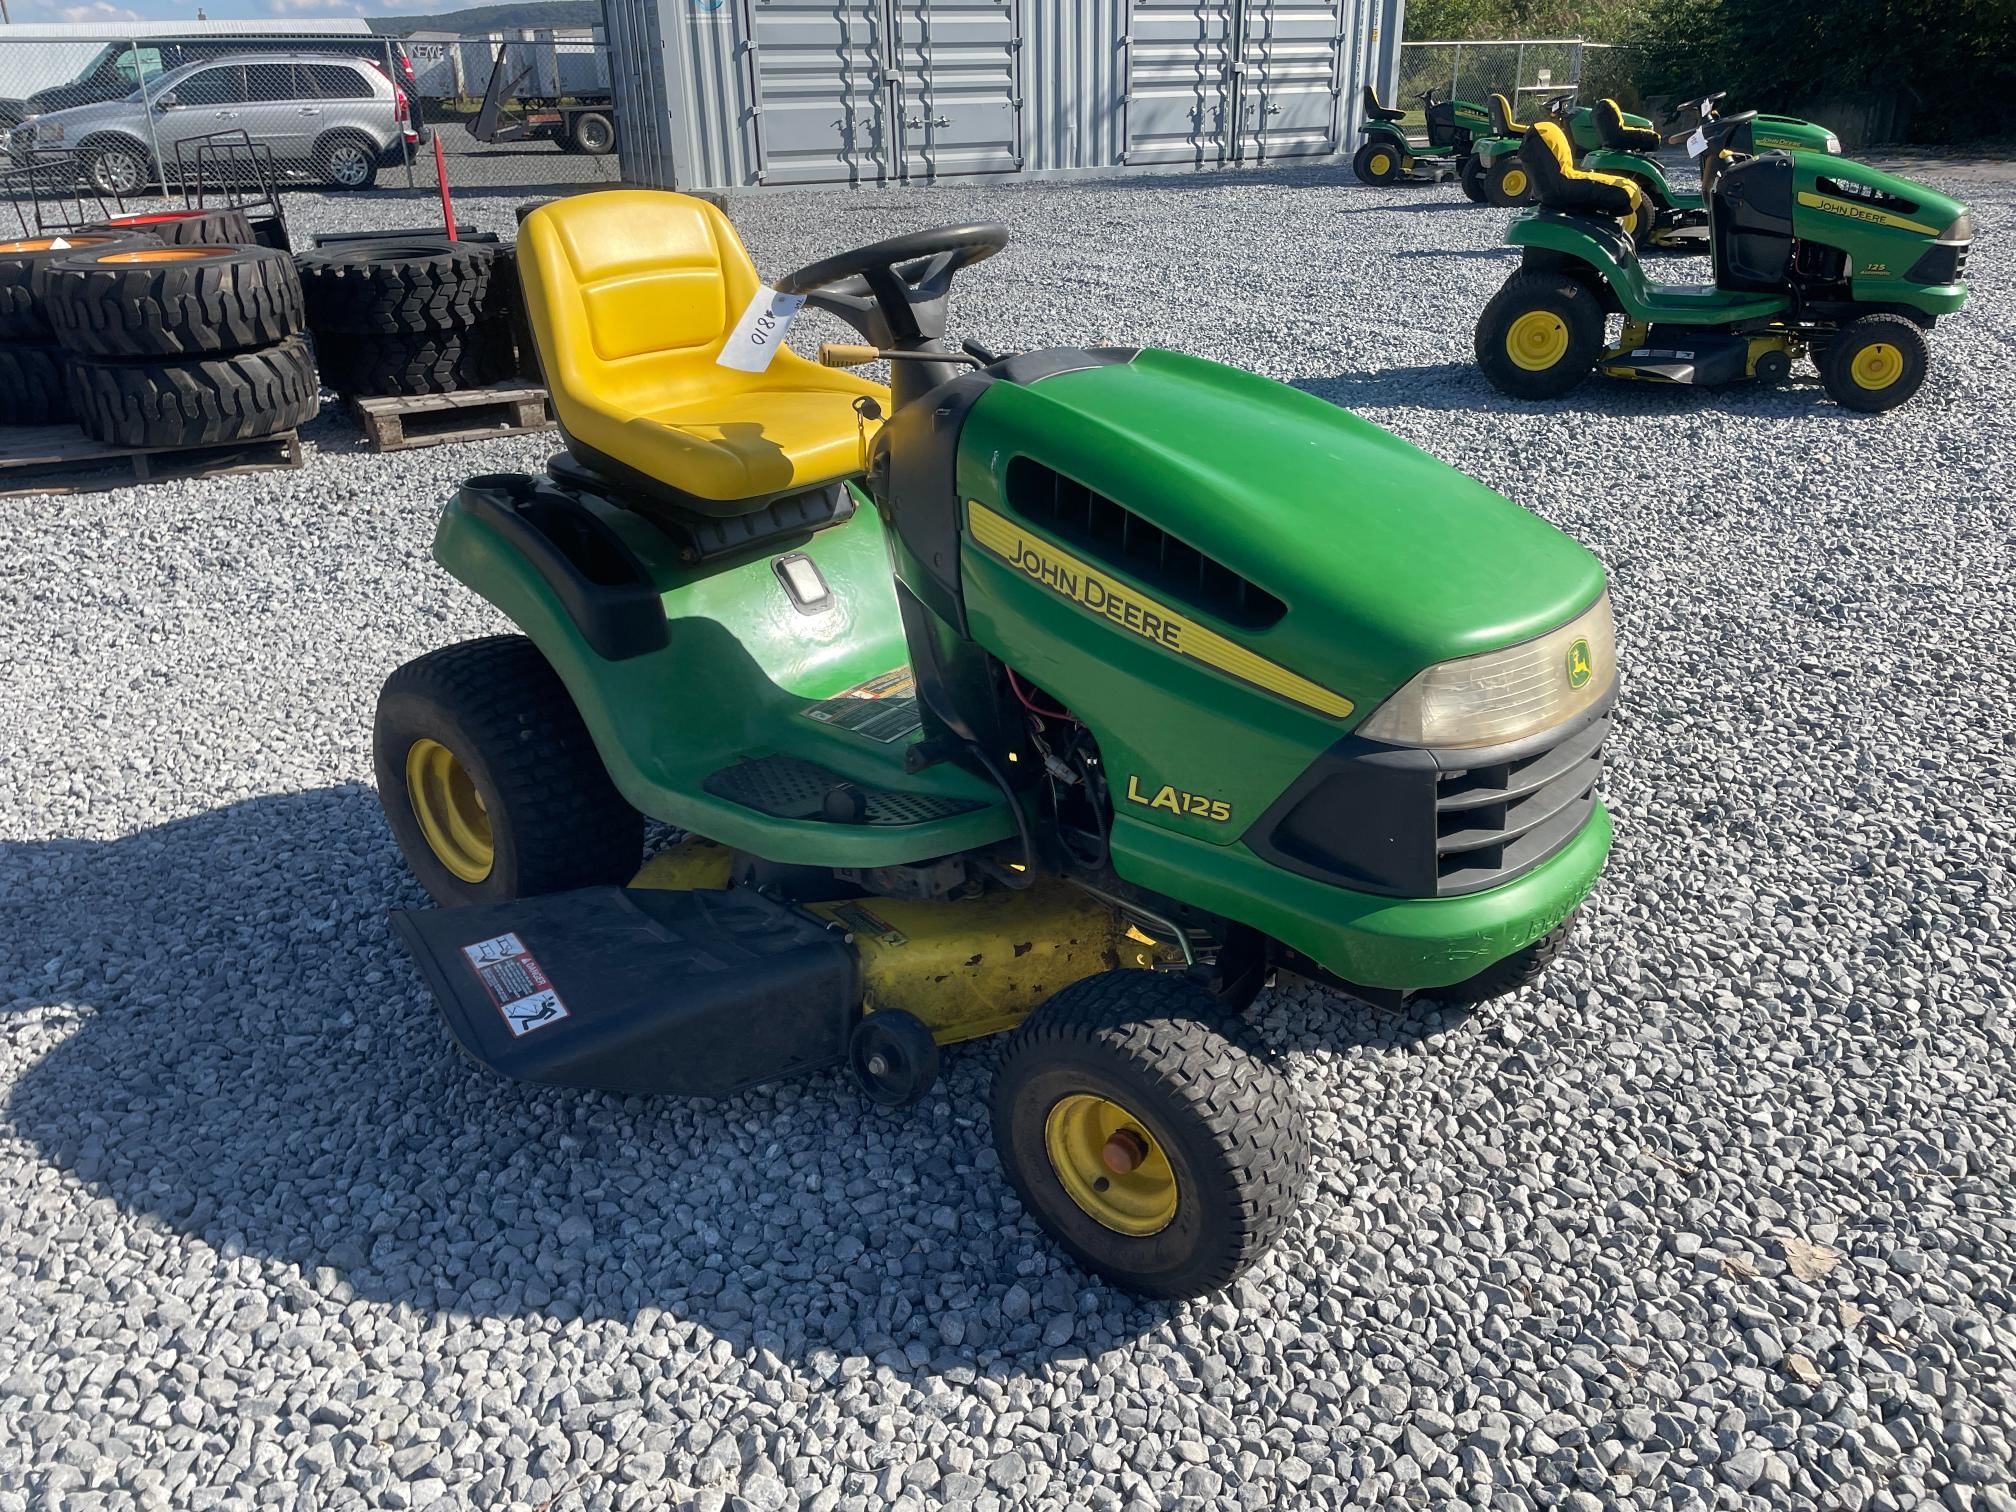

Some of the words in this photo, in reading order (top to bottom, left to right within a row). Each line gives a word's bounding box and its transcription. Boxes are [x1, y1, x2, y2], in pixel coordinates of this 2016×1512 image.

[1818, 200, 1848, 216] JOHN
[1849, 207, 1887, 224] DEERE
[1867, 263, 1886, 271] 125
[1008, 539, 1078, 597] JOHN
[1084, 574, 1182, 649] DEERE
[1127, 775, 1231, 822] LA125
[525, 962, 546, 986] DANGER
